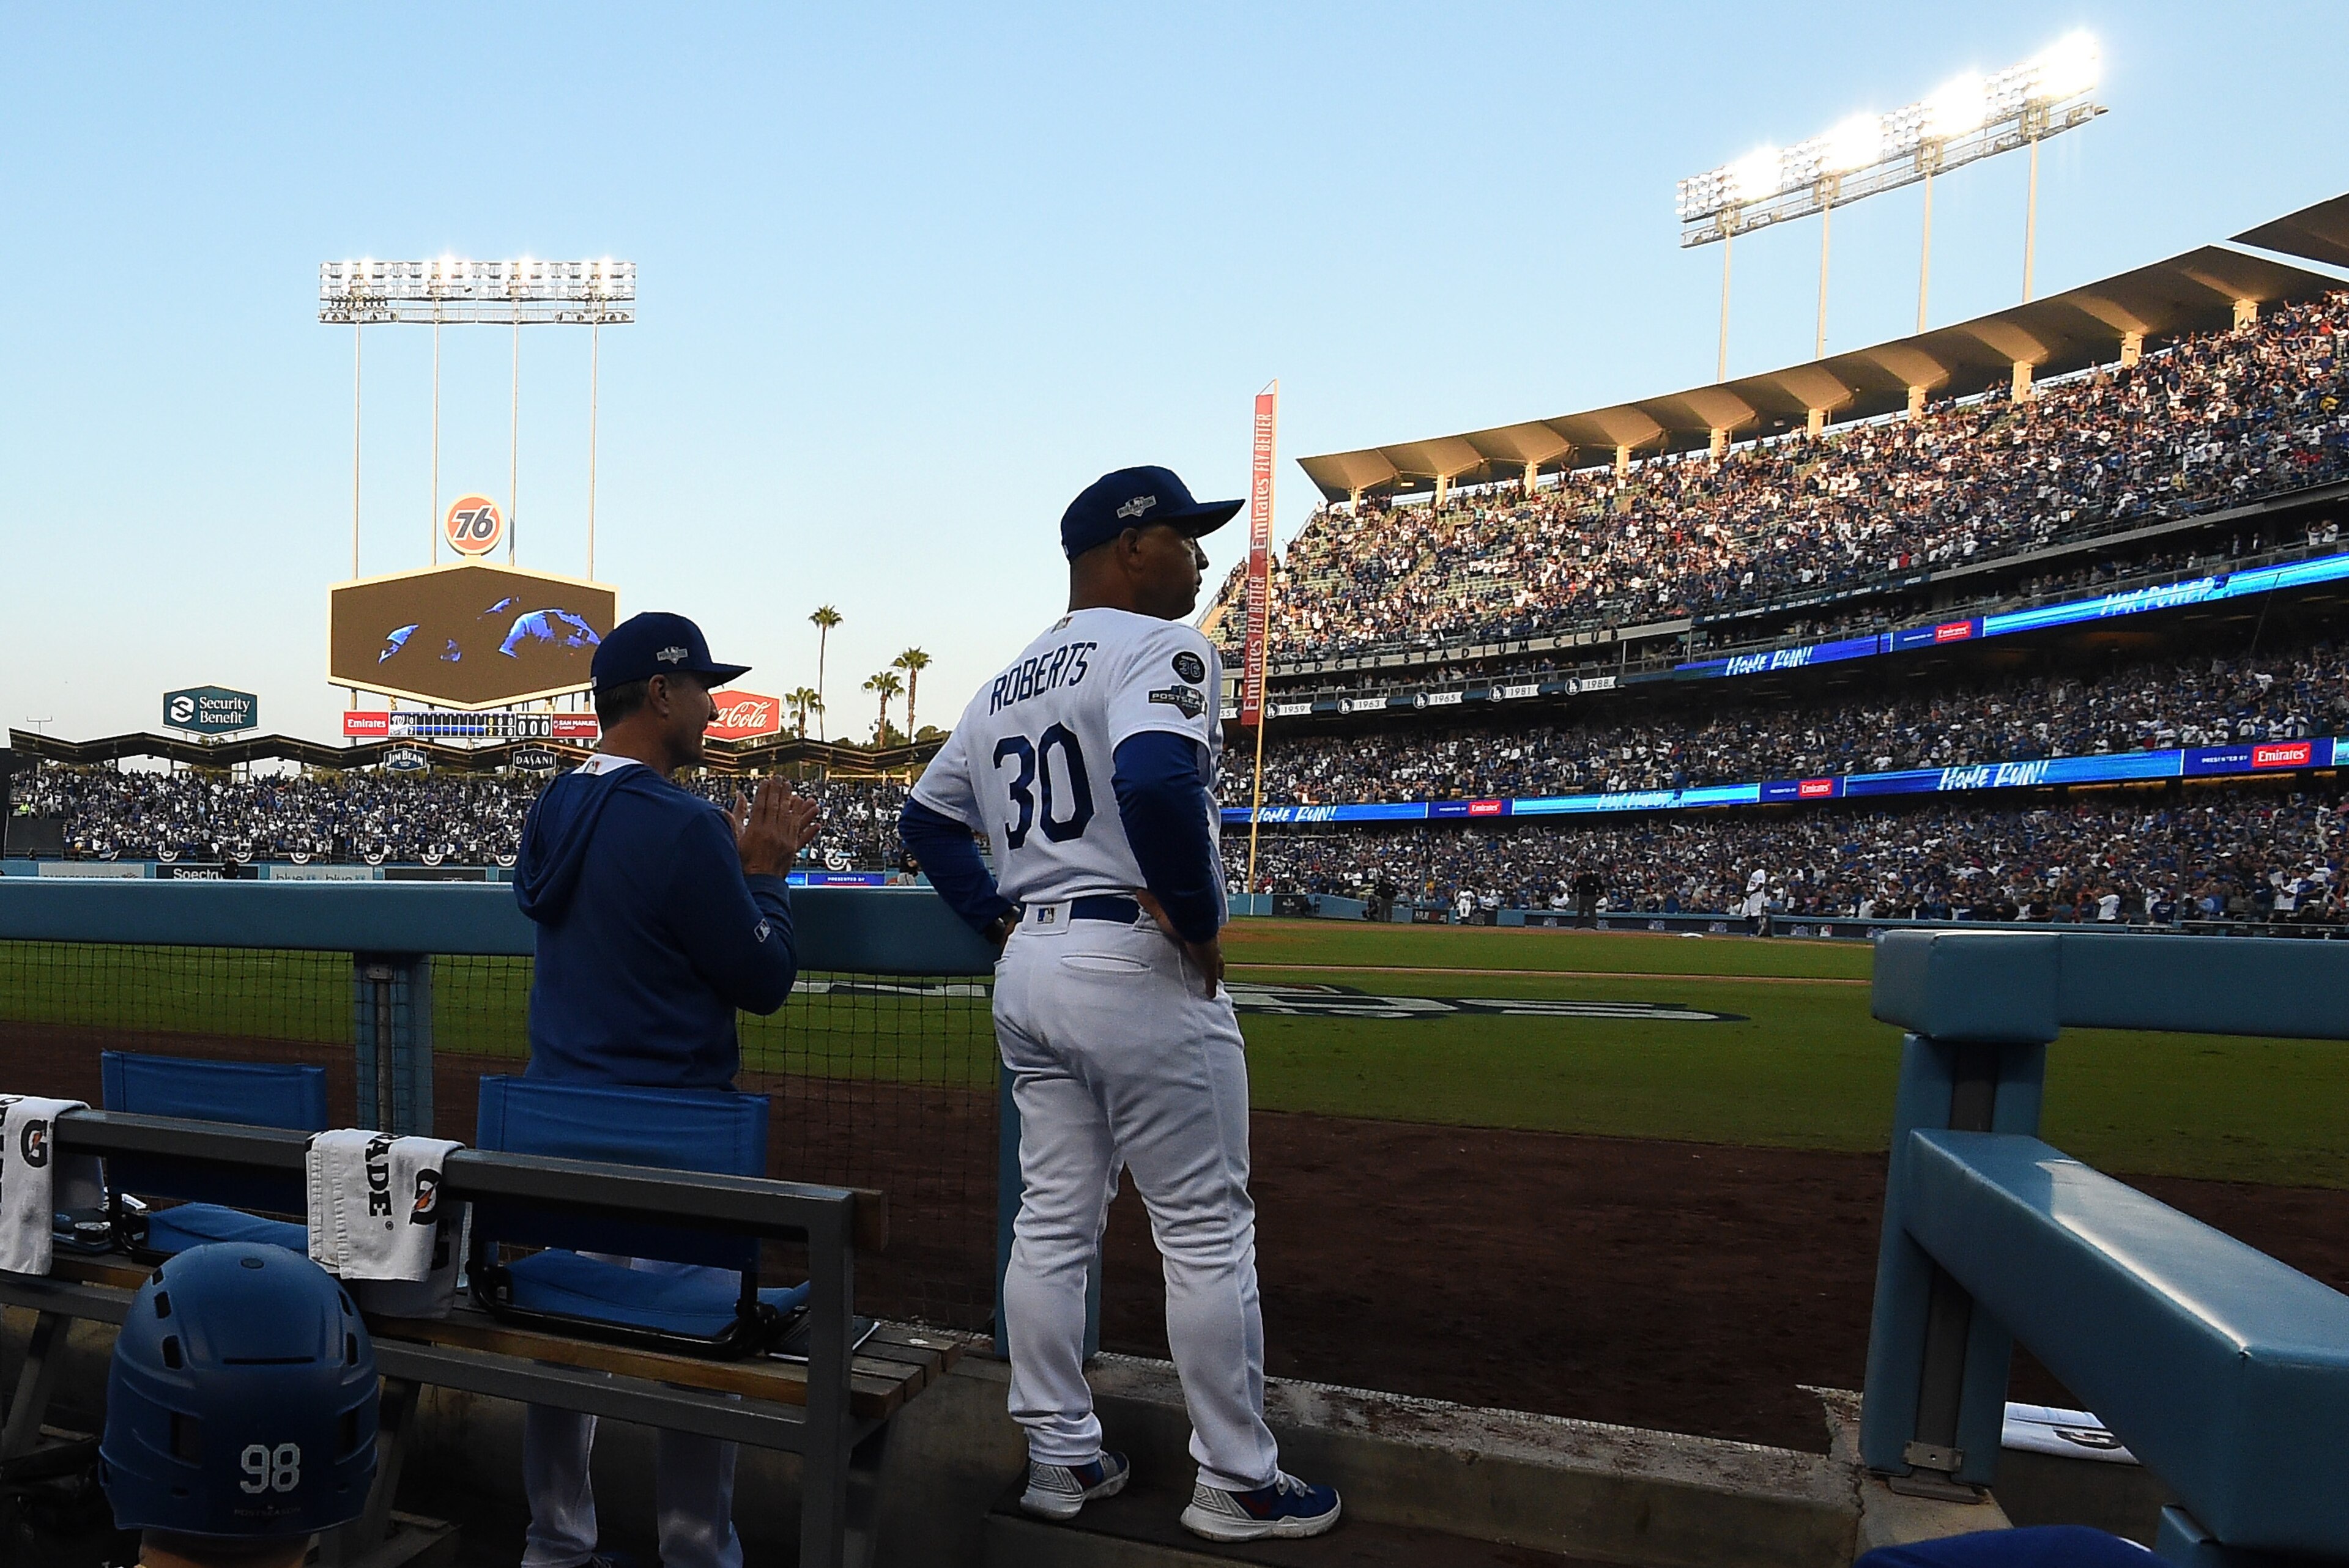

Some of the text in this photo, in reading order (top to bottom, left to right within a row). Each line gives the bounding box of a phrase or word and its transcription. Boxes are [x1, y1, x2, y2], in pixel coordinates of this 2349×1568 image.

[1252, 413, 1272, 550] Emirates FLY BETTER
[453, 506, 495, 540] 76
[1244, 575, 1265, 711] Emirates FLY BETTER
[1274, 629, 1618, 675] DODGER STADIUM CLUB
[1179, 660, 1200, 678] 36
[990, 642, 1097, 716] ROBERTS
[199, 697, 250, 712] Security
[1152, 693, 1201, 706] POSTSEA
[200, 711, 243, 723] Benefit
[1285, 705, 1305, 714] 1959
[347, 719, 386, 728] Emirates
[518, 721, 549, 735] 0 0 0
[386, 750, 423, 766] JIM BEAM
[516, 754, 553, 765] DASANI
[2258, 749, 2305, 762] Emirates
[993, 721, 1094, 849] 30
[1802, 783, 1830, 794] Emirates
[1471, 803, 1499, 812] Emirates
[240, 1443, 300, 1493] 98
